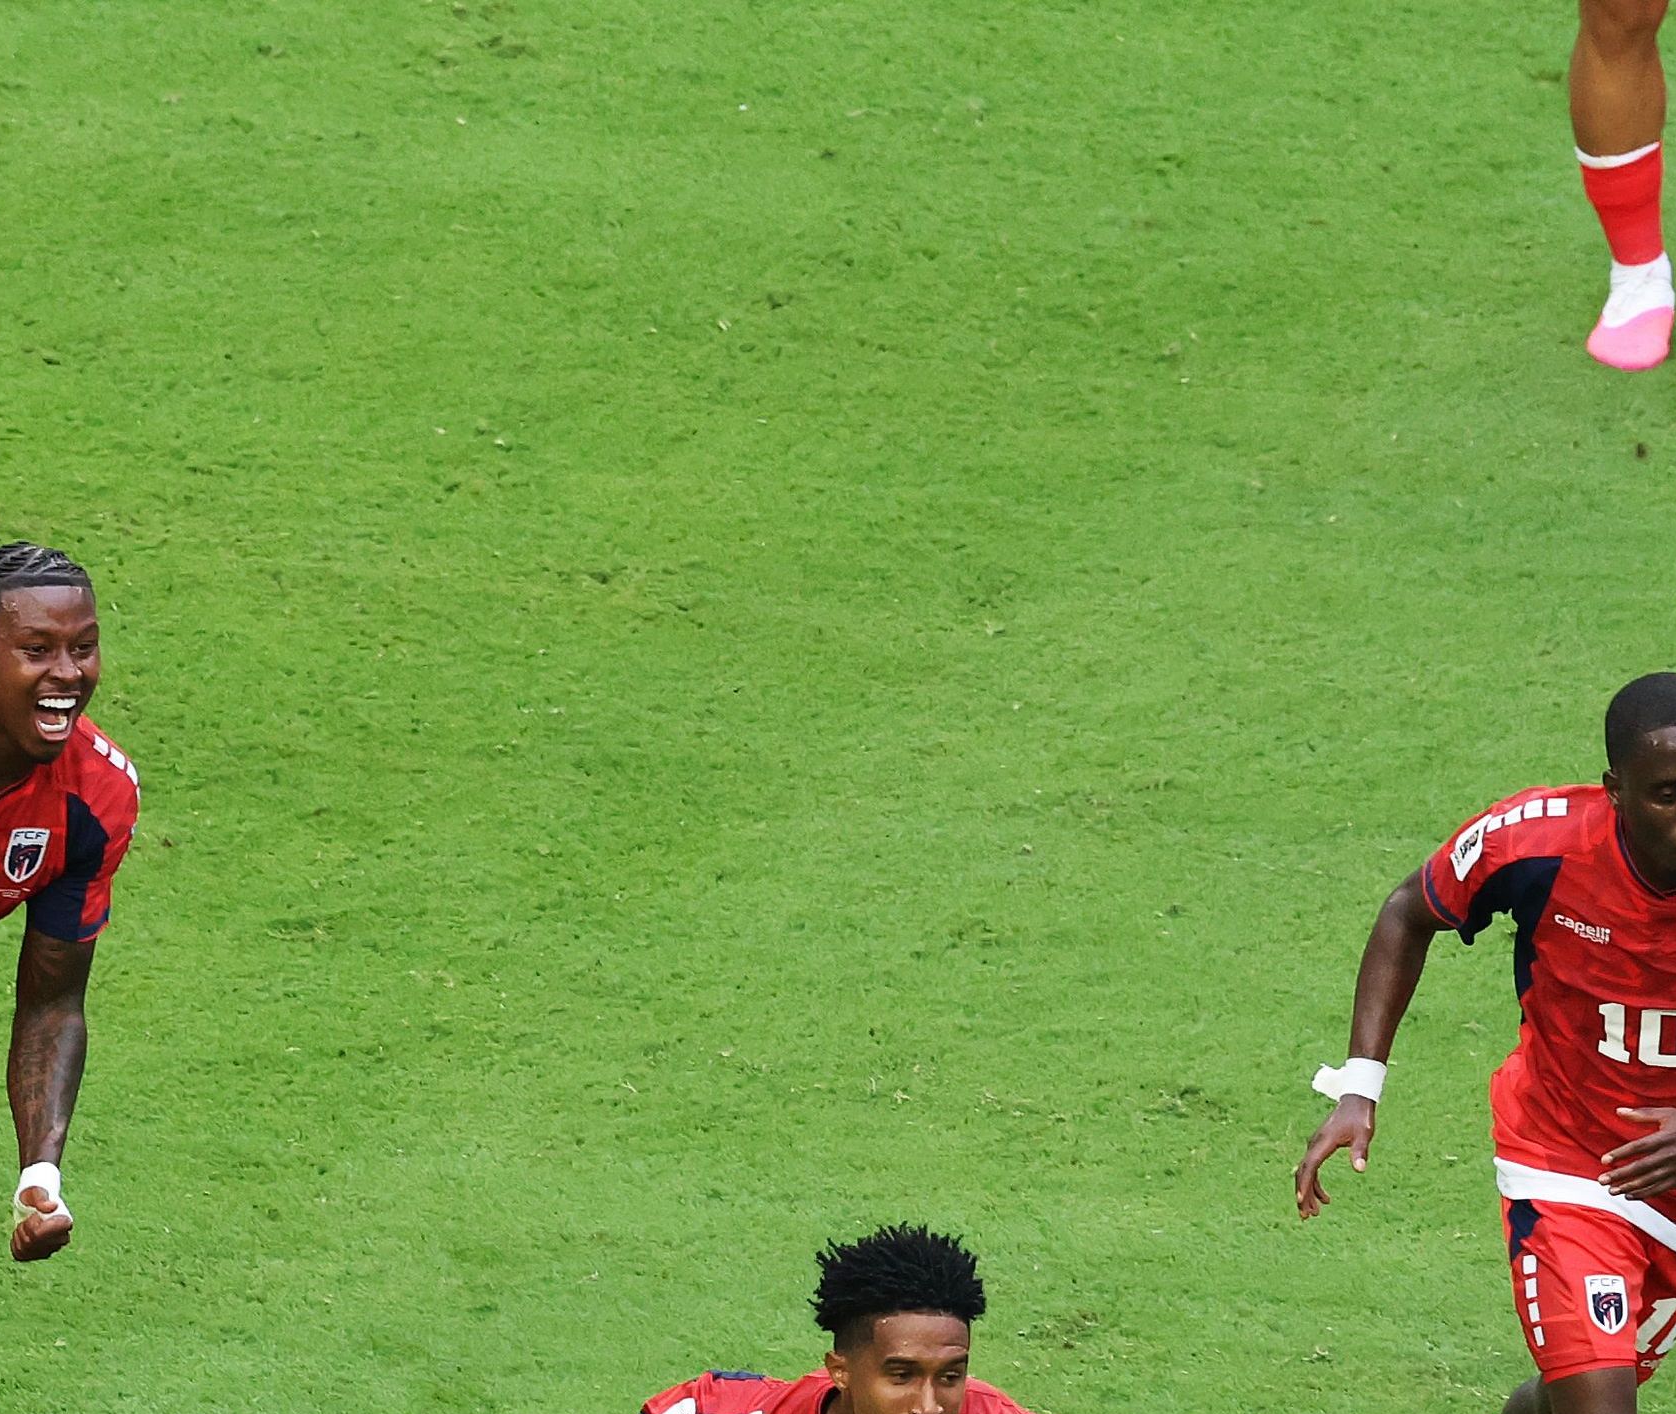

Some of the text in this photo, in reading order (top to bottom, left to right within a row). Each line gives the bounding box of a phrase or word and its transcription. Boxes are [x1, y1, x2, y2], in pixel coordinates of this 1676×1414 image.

[13, 831, 47, 840] FCF
[1554, 914, 1612, 943] capelli
[1590, 1277, 1621, 1288] FCF
